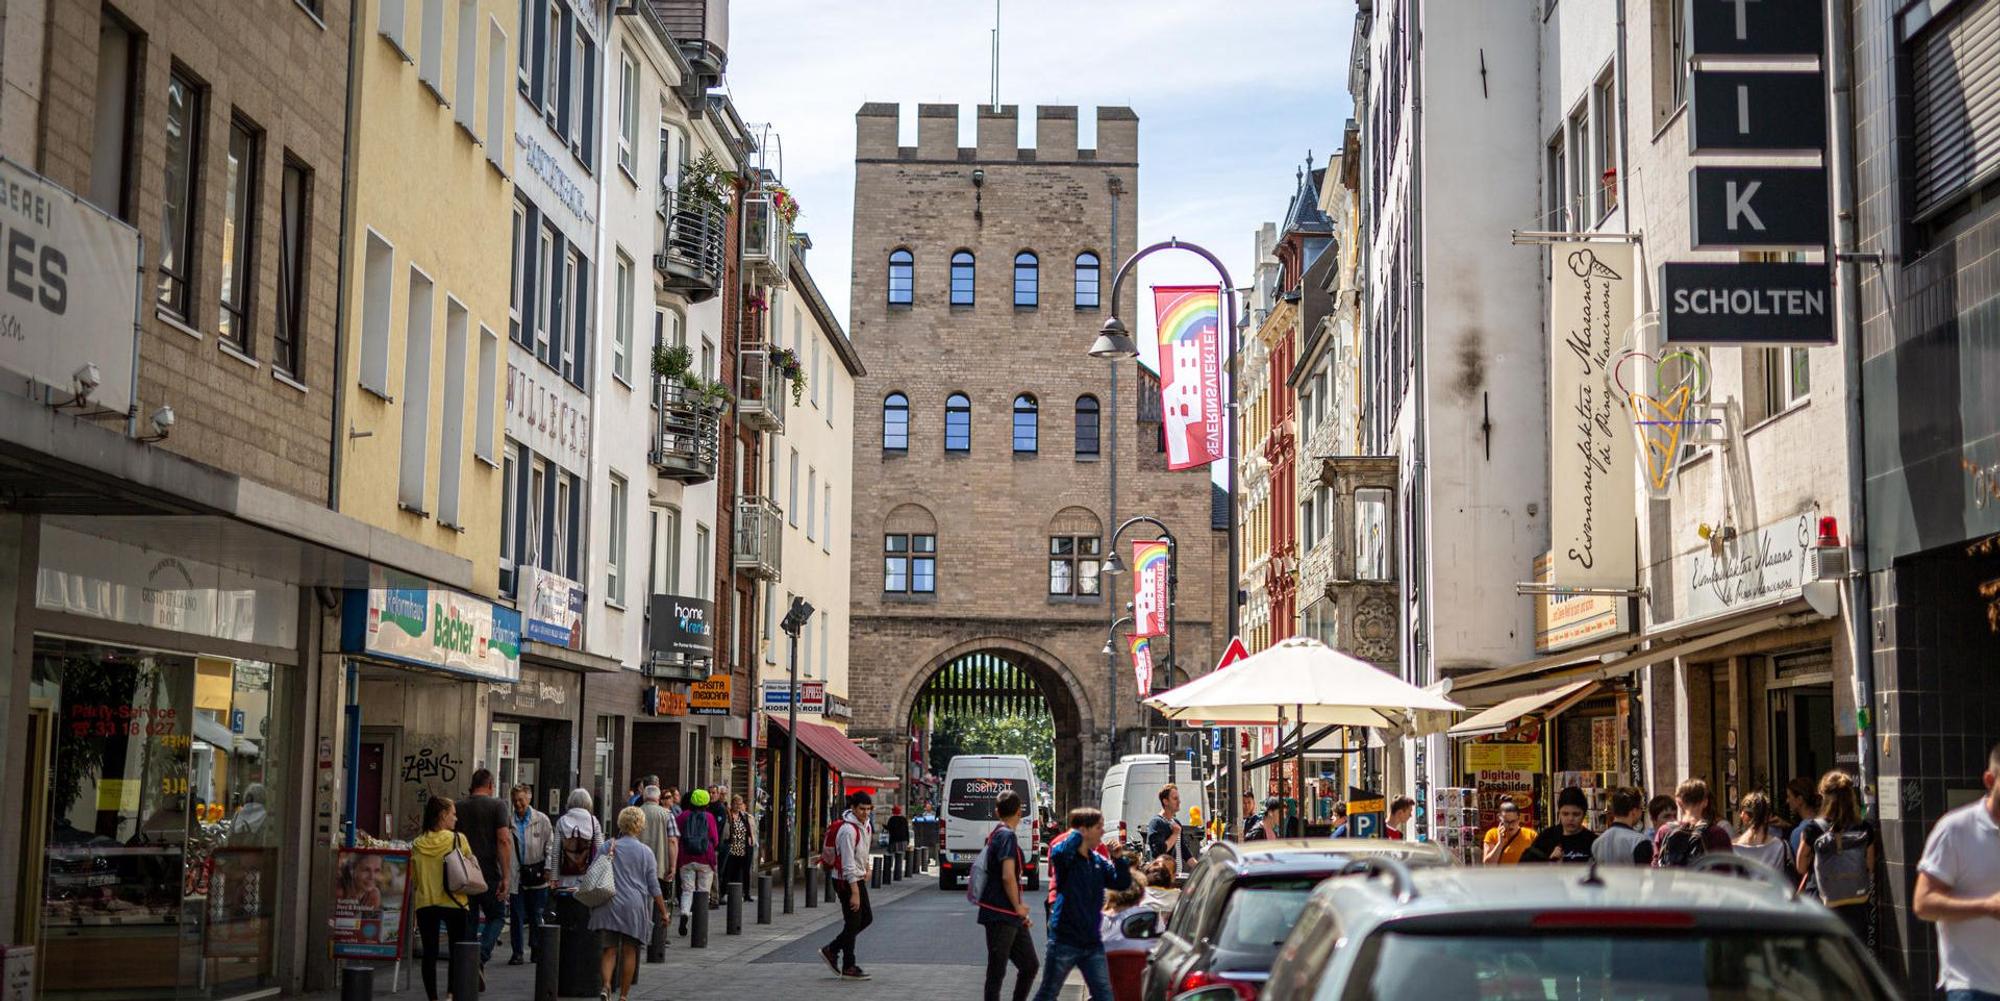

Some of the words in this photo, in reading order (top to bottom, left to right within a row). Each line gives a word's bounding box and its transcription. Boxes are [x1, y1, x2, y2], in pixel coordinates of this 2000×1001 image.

[1673, 288, 1825, 315] SCHOLTEN
[1566, 272, 1592, 376] Marano
[674, 602, 704, 620] home
[434, 602, 474, 655] Bacher
[698, 681, 725, 690] CASITA
[803, 686, 822, 700] EXPRESS
[1481, 770, 1520, 782] Digitale
[1479, 780, 1532, 791] Passbilder
[1358, 816, 1371, 835] P
